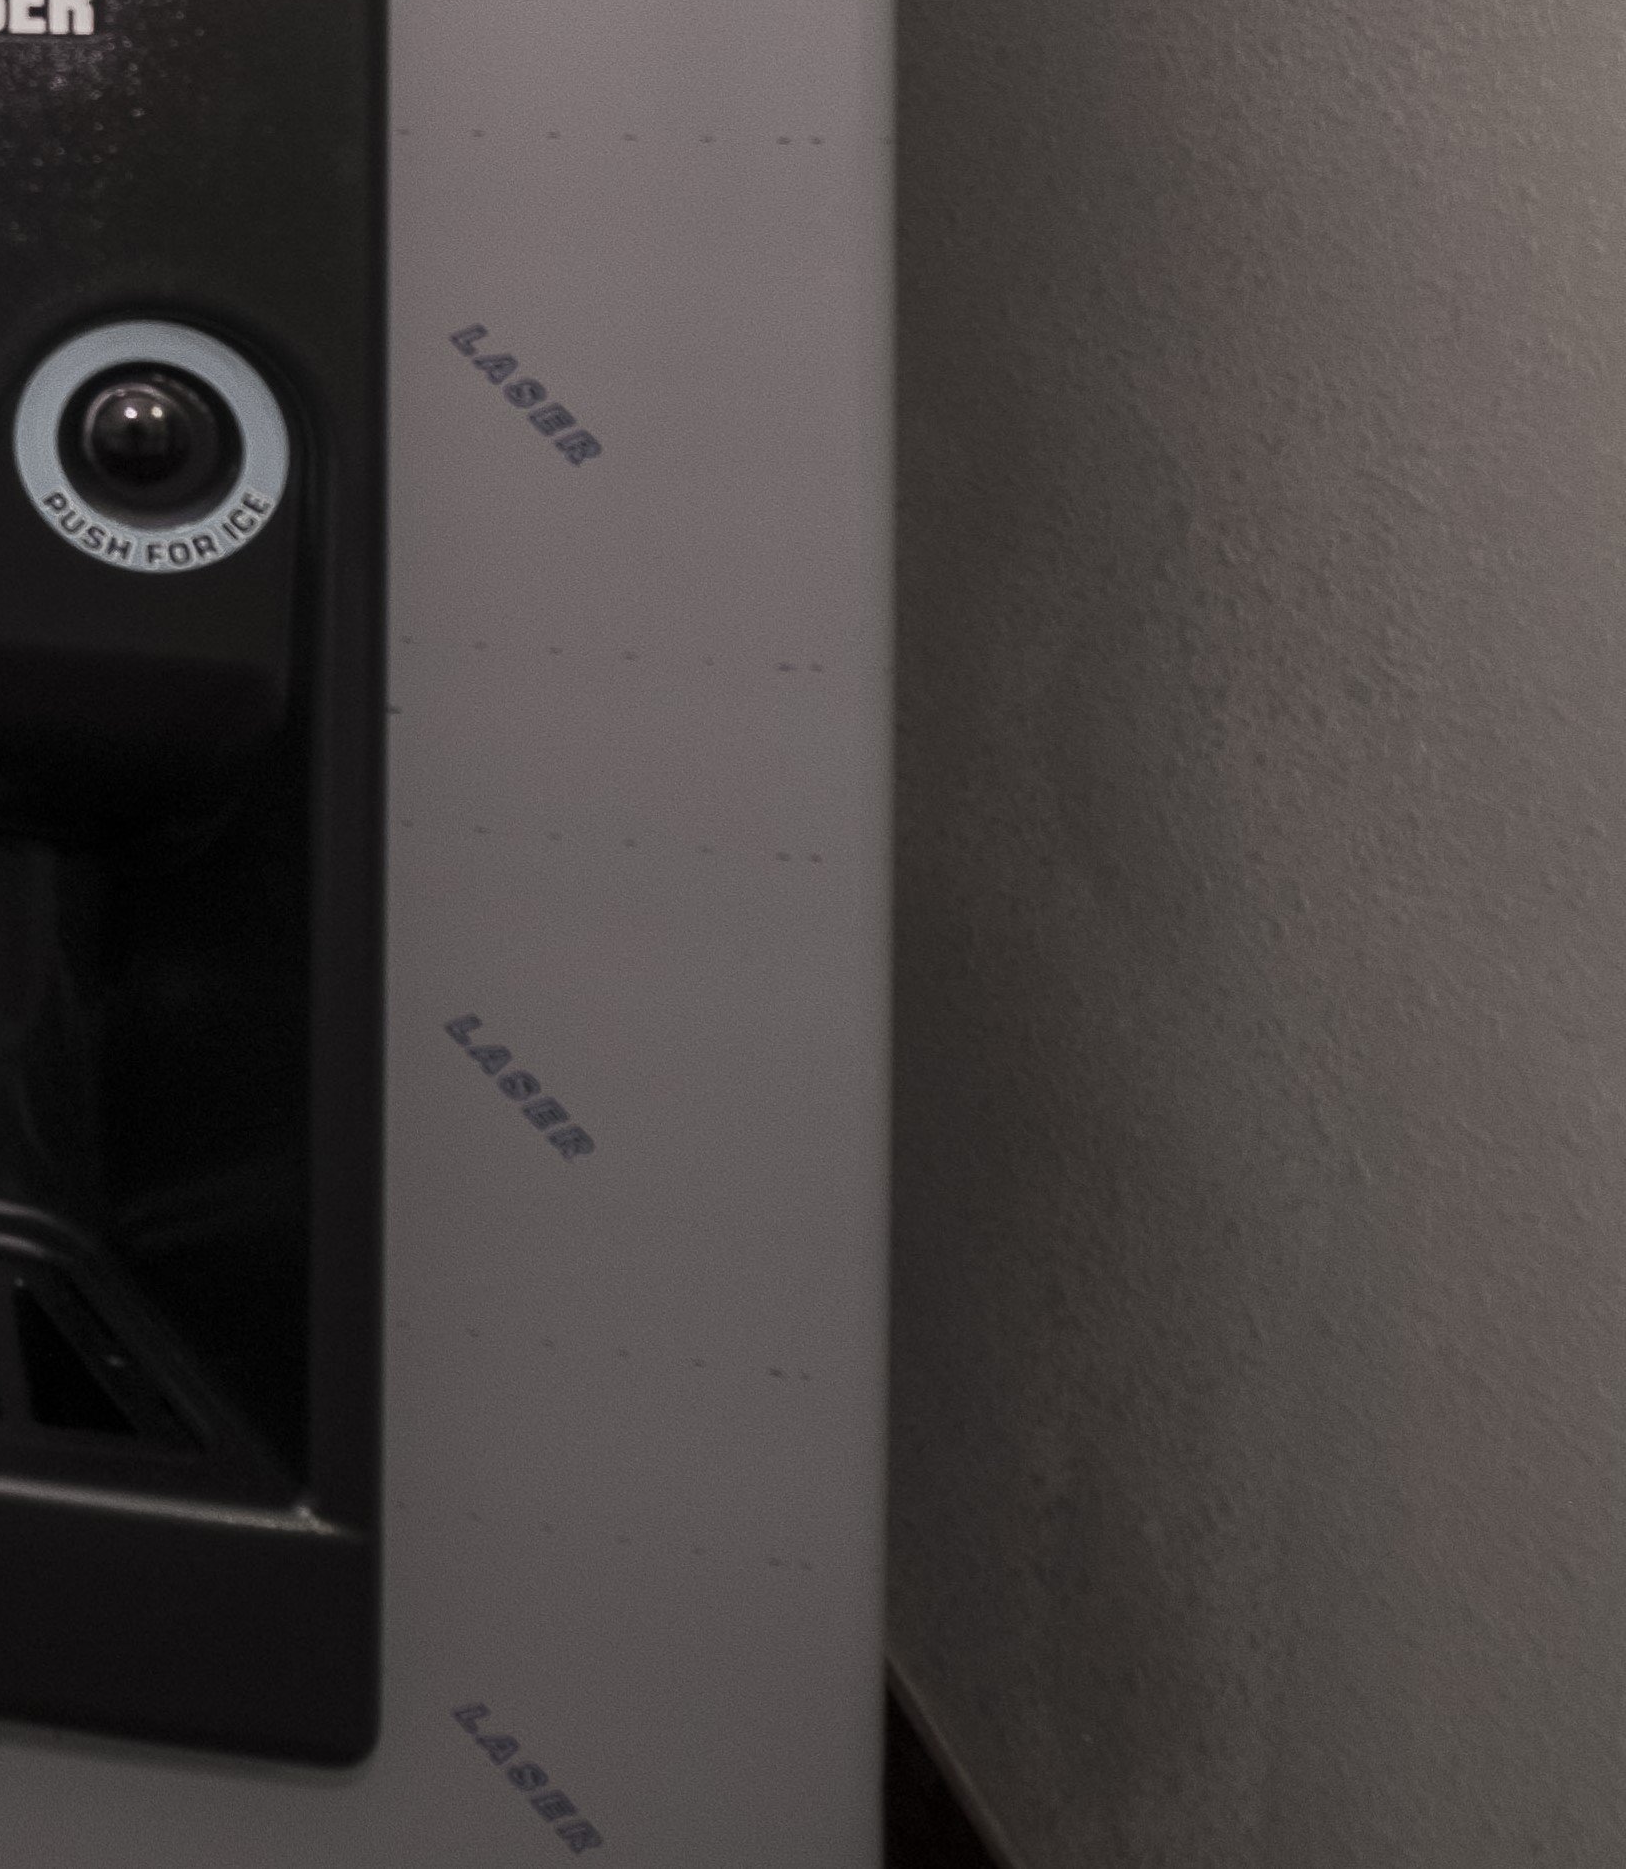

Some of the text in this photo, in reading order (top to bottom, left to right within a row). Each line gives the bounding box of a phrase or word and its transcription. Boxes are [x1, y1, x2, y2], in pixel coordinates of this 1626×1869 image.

[450, 323, 602, 468] LASER
[43, 491, 274, 566] PUSH FOR ICE
[445, 1013, 595, 1161] LASER
[452, 1702, 603, 1855] LASER
